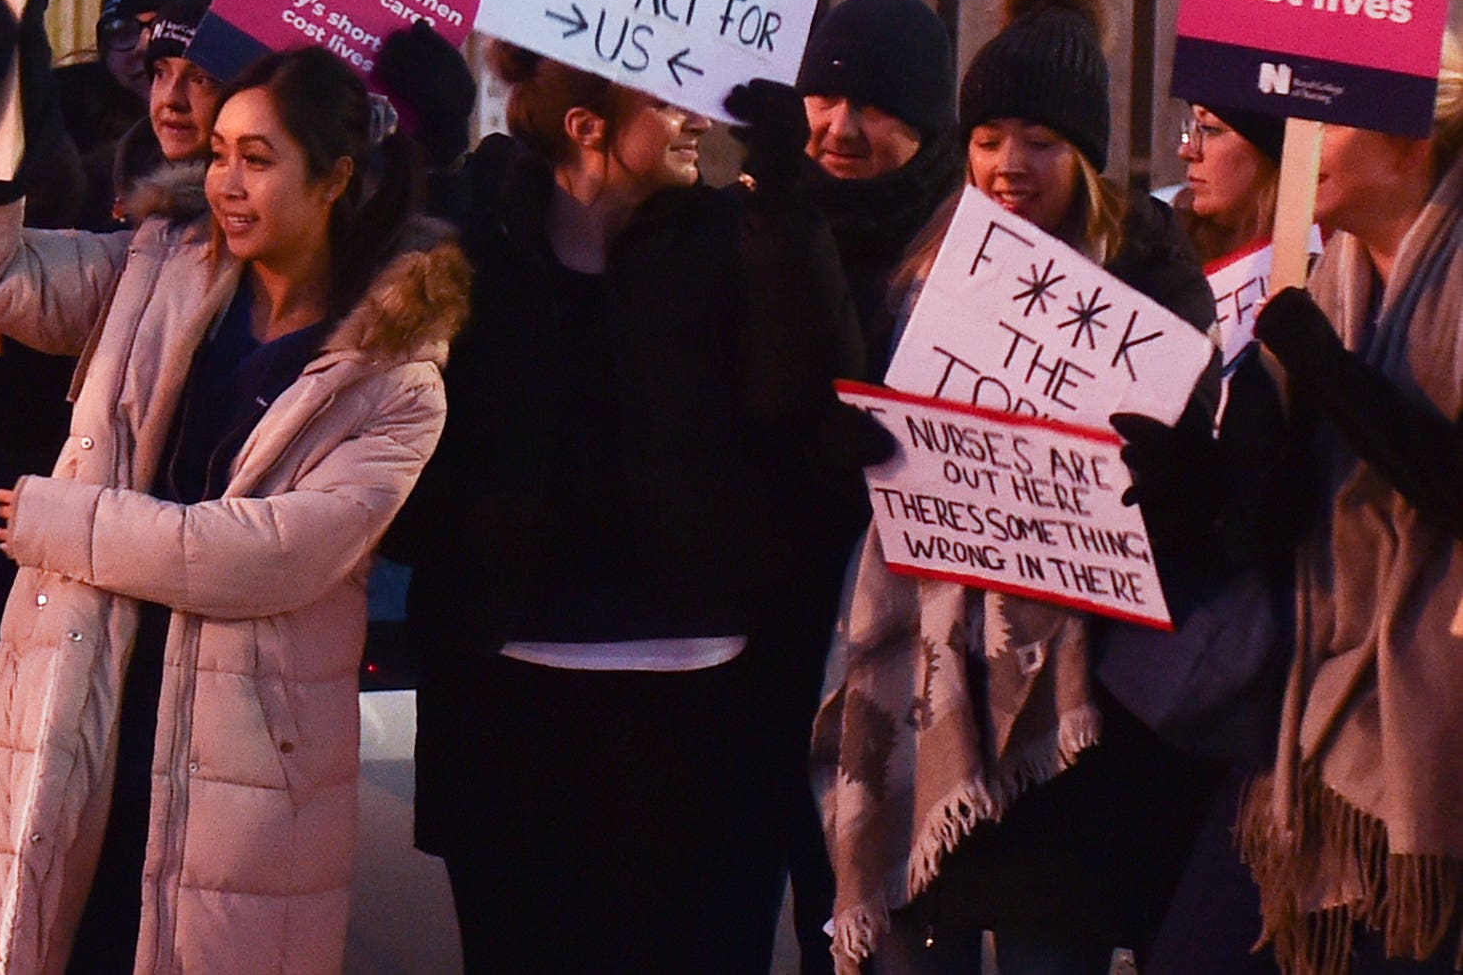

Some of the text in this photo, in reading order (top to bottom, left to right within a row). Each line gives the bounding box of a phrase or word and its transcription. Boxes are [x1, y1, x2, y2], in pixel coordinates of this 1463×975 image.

[281, 8, 374, 73] cost lives
[594, 8, 654, 72] US
[999, 320, 1096, 412] THE
[905, 414, 1111, 492] NURSES ARE
[943, 461, 1092, 517] OUT HERE
[875, 487, 1150, 565] THERES SOMETHING
[904, 531, 1146, 606] WRONG IN THERE
